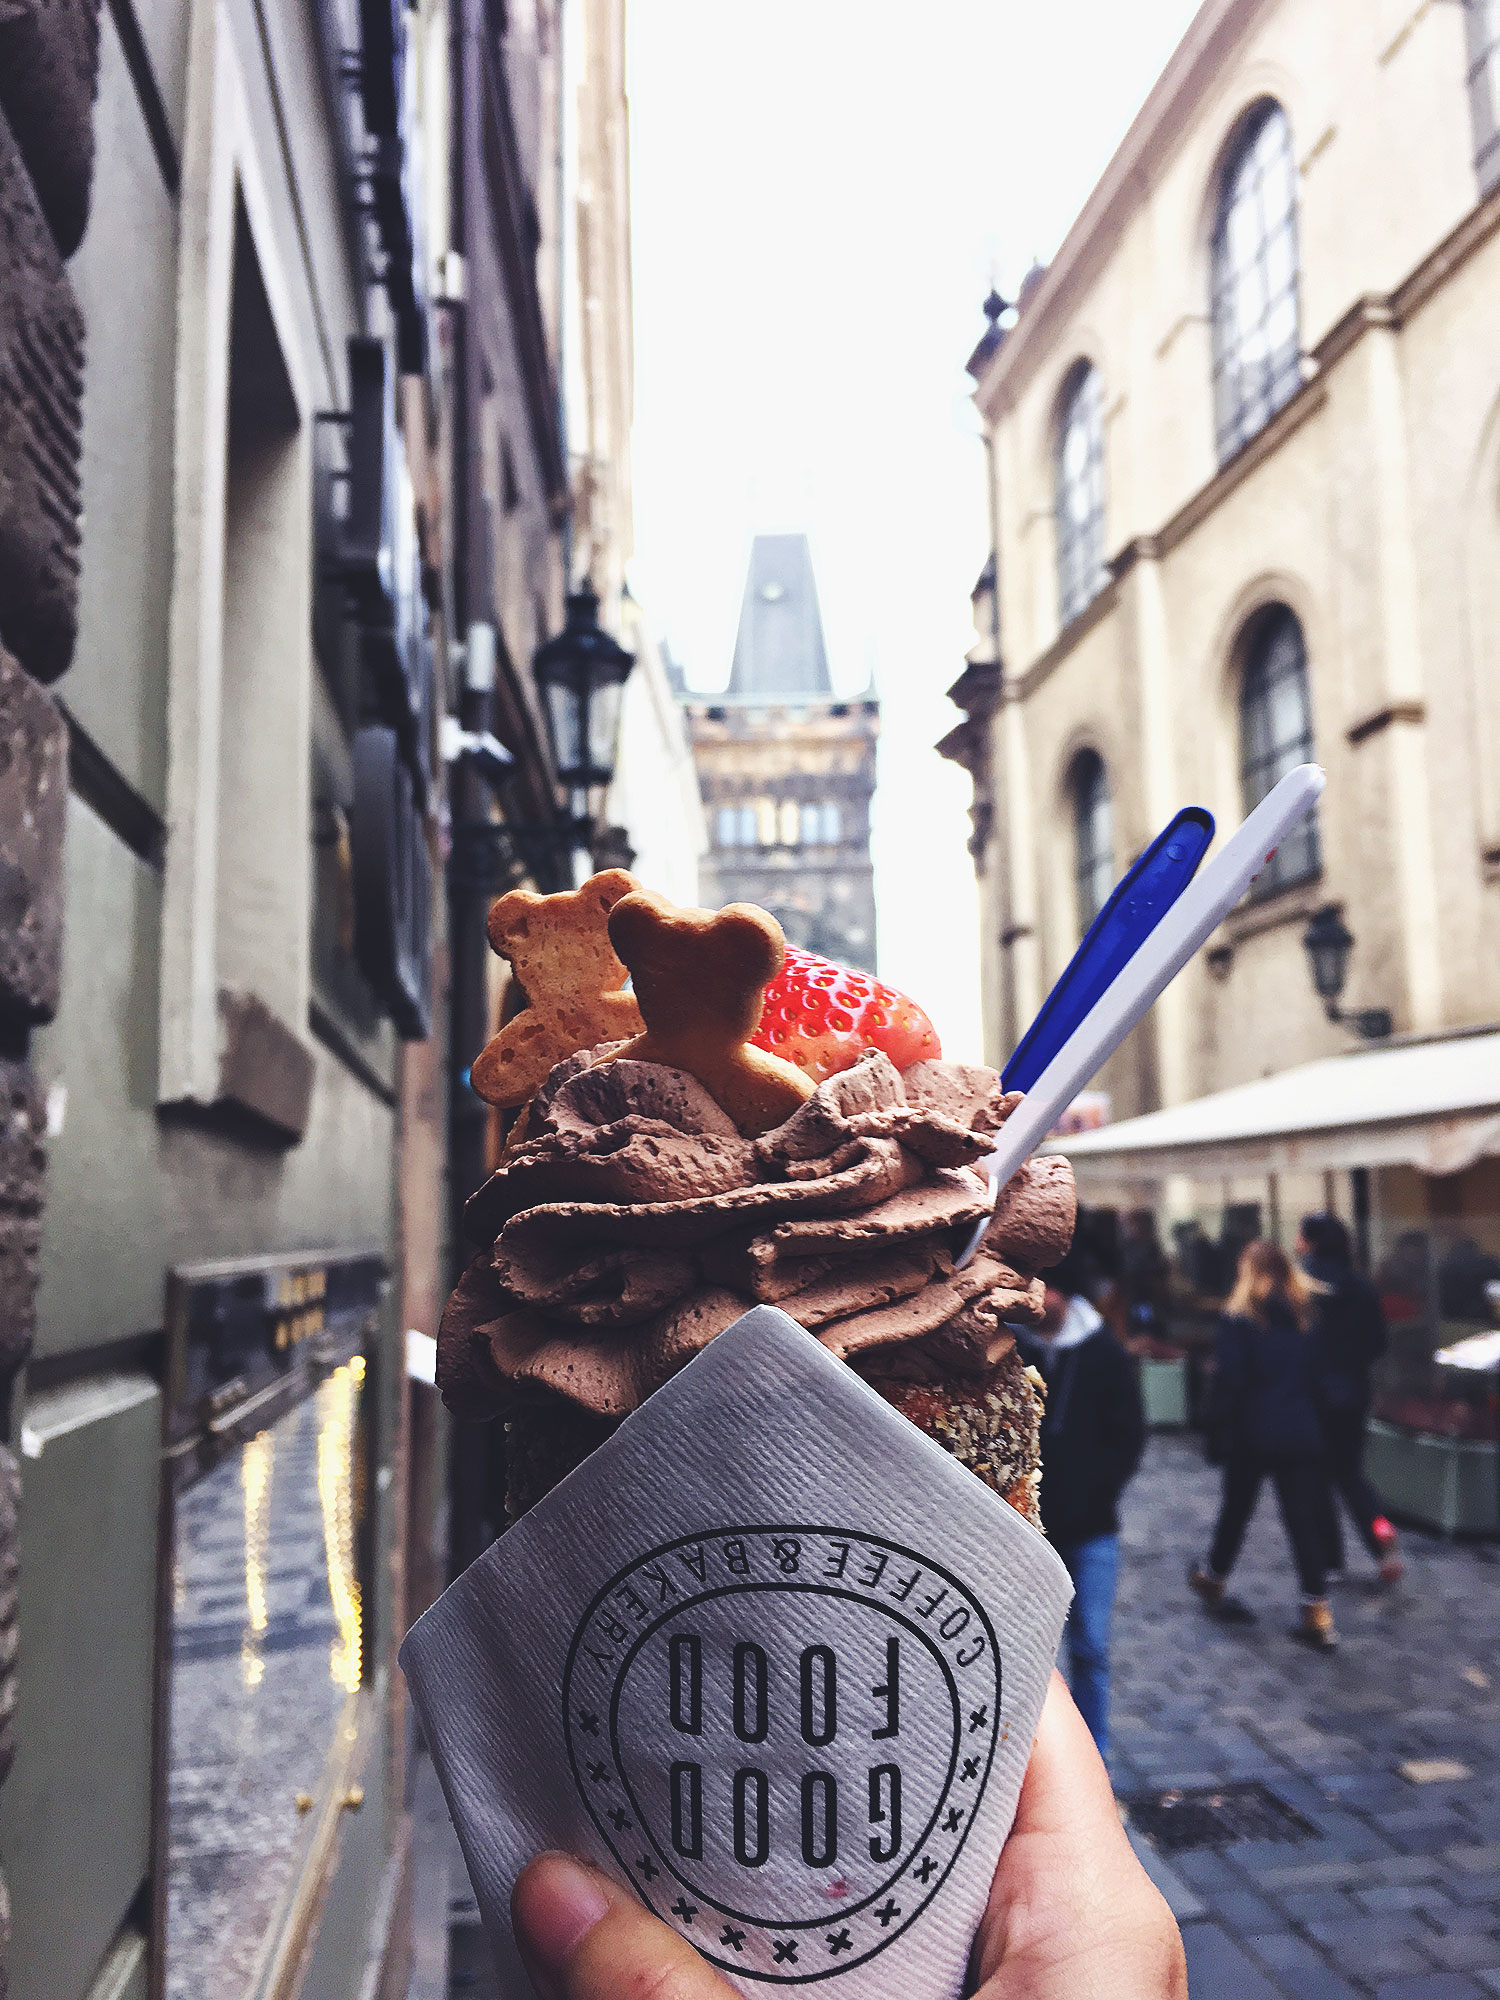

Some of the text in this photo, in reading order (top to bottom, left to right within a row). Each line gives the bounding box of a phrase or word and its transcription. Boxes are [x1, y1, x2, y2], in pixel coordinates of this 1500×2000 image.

[584, 1538, 986, 1674] COFFEE & BAKERY
[669, 1634, 899, 1746] FOOD
[670, 1761, 900, 1868] GOOD
